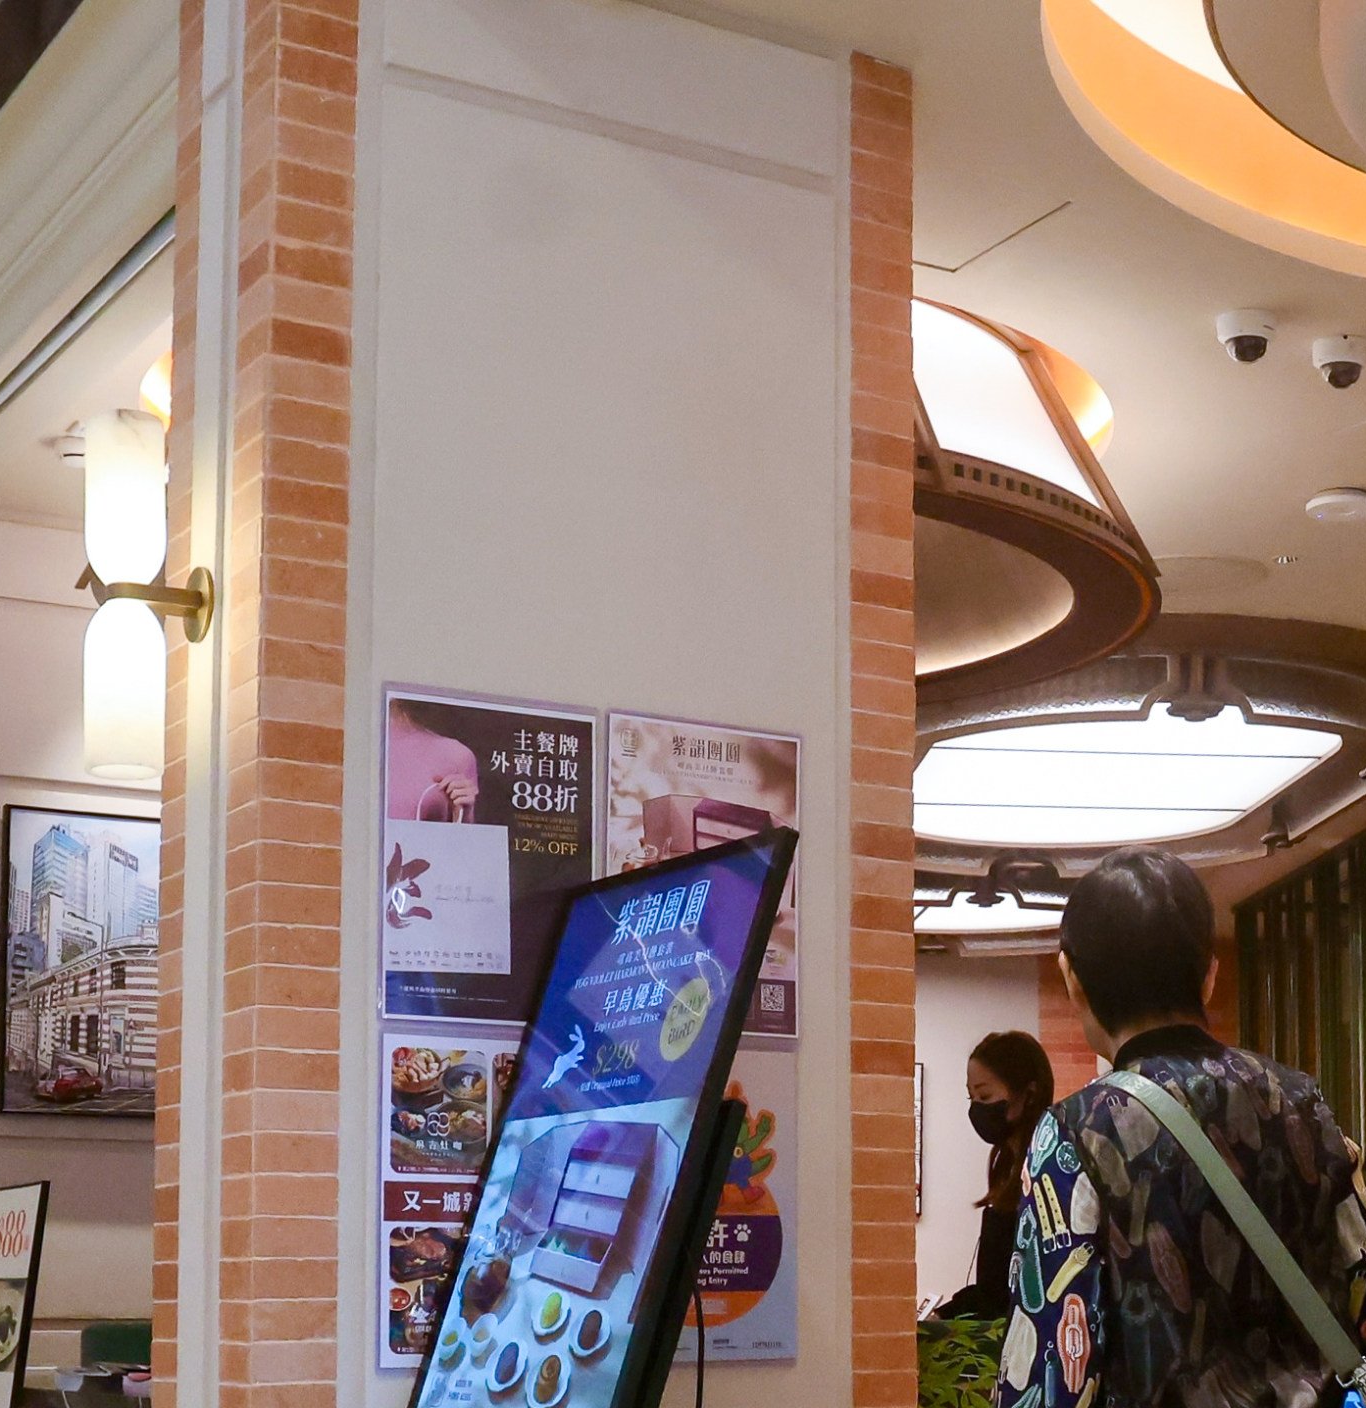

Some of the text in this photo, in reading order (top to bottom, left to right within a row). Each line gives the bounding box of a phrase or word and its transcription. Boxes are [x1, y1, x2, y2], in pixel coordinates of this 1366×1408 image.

[514, 729, 578, 757] 主餐牌
[490, 750, 578, 781] 外賣自取
[512, 781, 578, 813] 88折
[515, 839, 578, 855] 12% OFF
[611, 880, 710, 945] 紫韻團圓
[603, 979, 667, 1017] 早鳥優惠
[592, 1039, 640, 1076] $298
[708, 1277, 728, 1286] Entry
